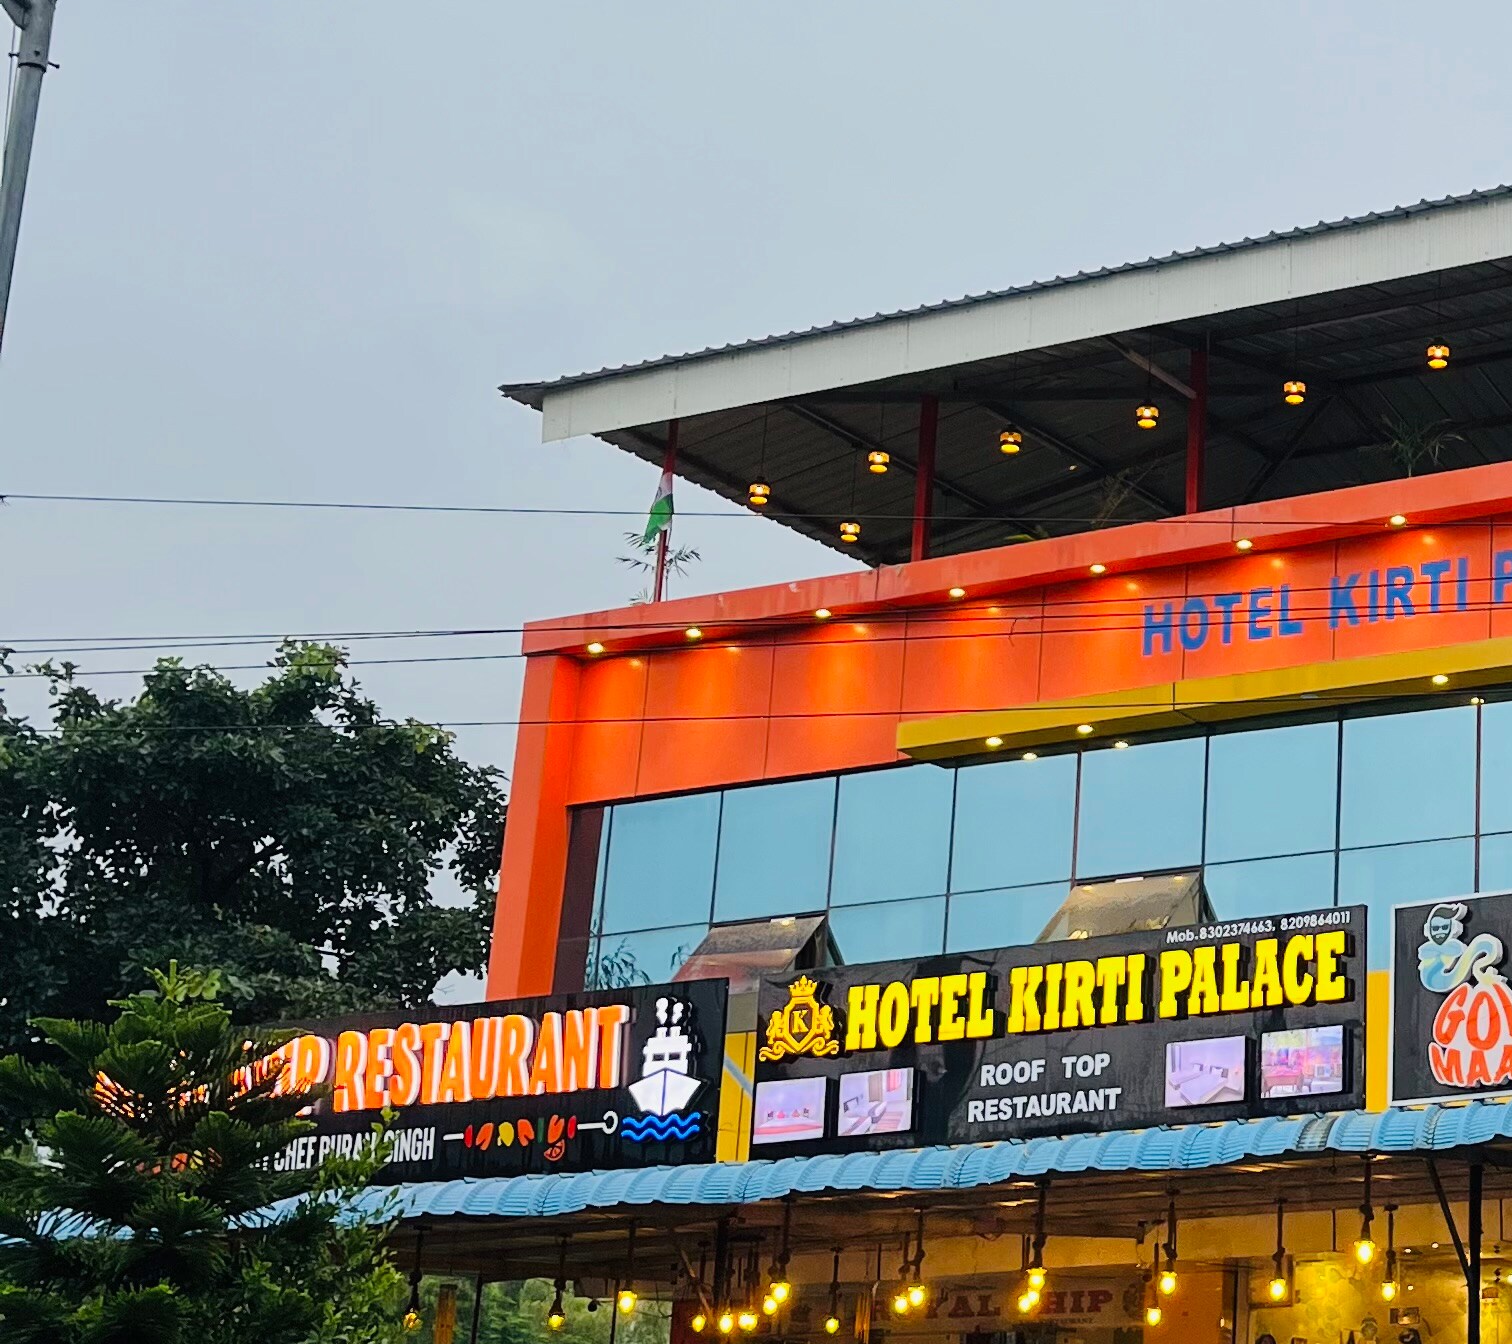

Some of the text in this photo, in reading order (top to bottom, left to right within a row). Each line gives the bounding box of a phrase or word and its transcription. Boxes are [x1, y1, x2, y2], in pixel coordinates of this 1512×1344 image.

[1142, 585, 1303, 656] HOTEL
[1329, 557, 1468, 629] KIRTI
[1280, 910, 1351, 931] 8209864011
[845, 930, 1348, 1051] HOTEL KIRTI PALACE
[793, 1009, 809, 1034] K
[333, 1003, 631, 1114] RESTAURANT
[979, 1052, 1111, 1088] ROOF TOP
[966, 1087, 1122, 1124] RESTAURANT
[869, 1290, 1001, 1322] RYAL
